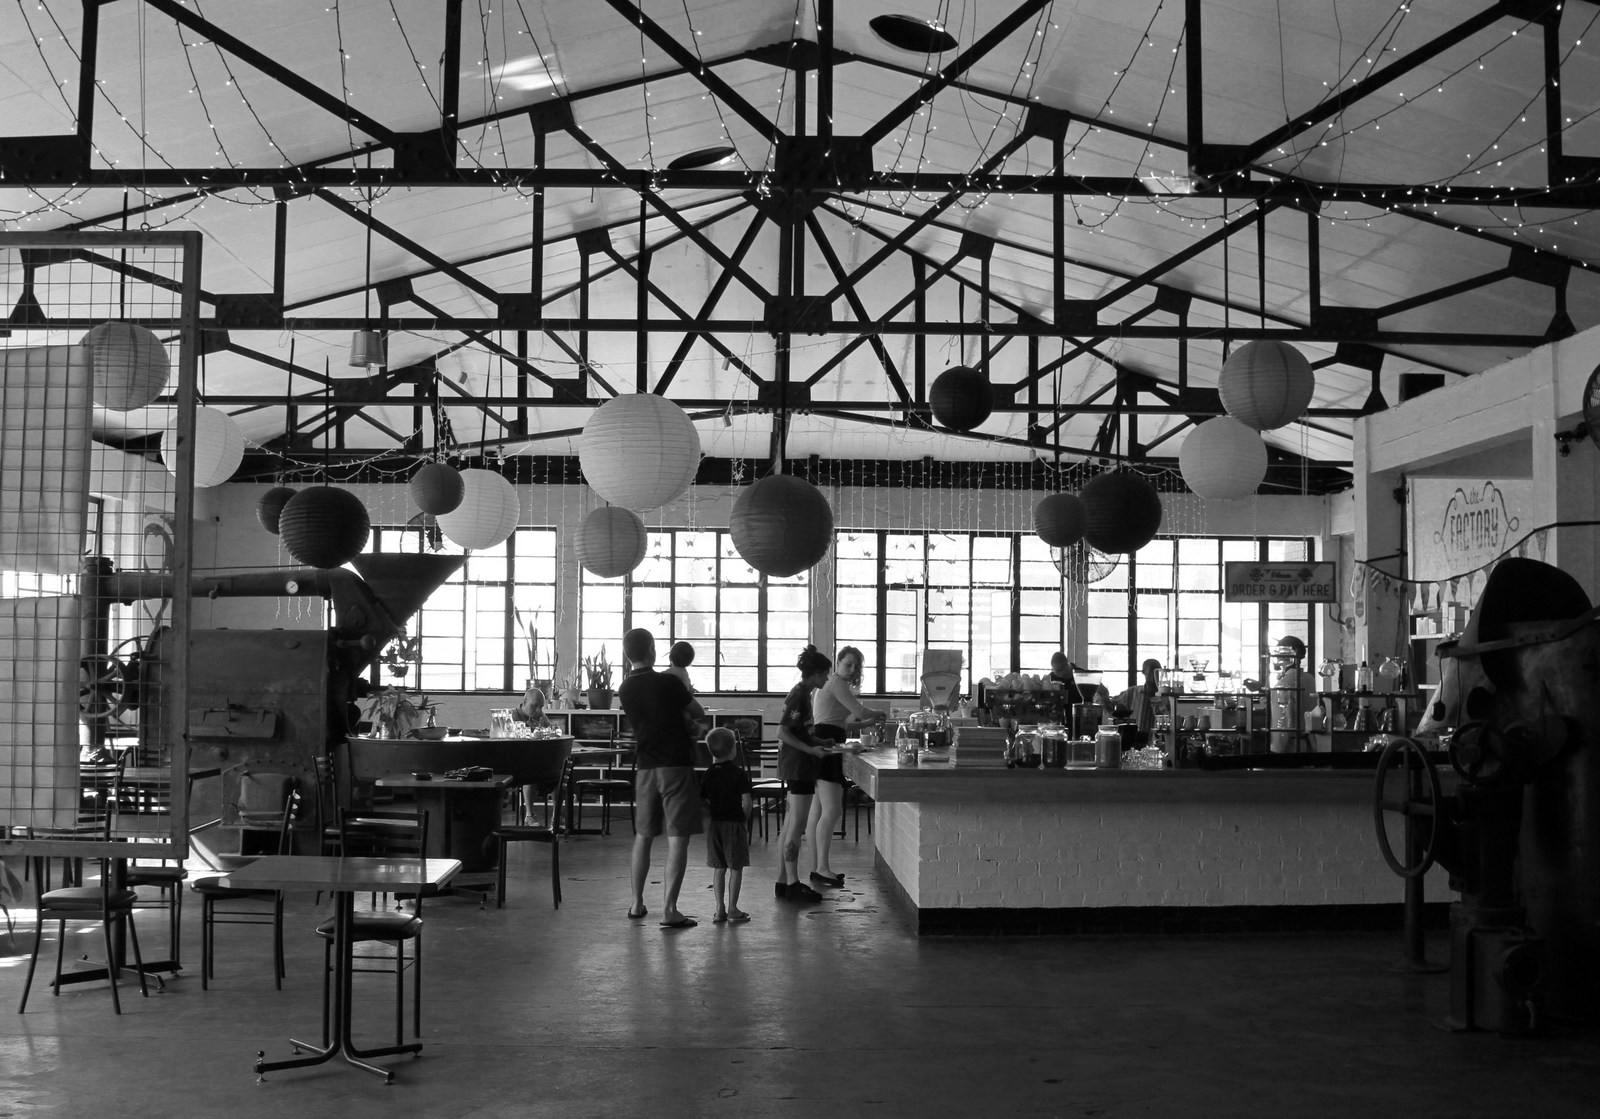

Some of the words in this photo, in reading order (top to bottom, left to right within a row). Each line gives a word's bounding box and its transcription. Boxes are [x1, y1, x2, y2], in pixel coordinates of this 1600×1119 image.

[1469, 487, 1480, 505] the
[1450, 507, 1499, 551] FACTORY
[1232, 584, 1266, 596] ORDER
[1269, 584, 1277, 596] &
[1280, 584, 1299, 596] PAY
[1303, 583, 1330, 596] HERE
